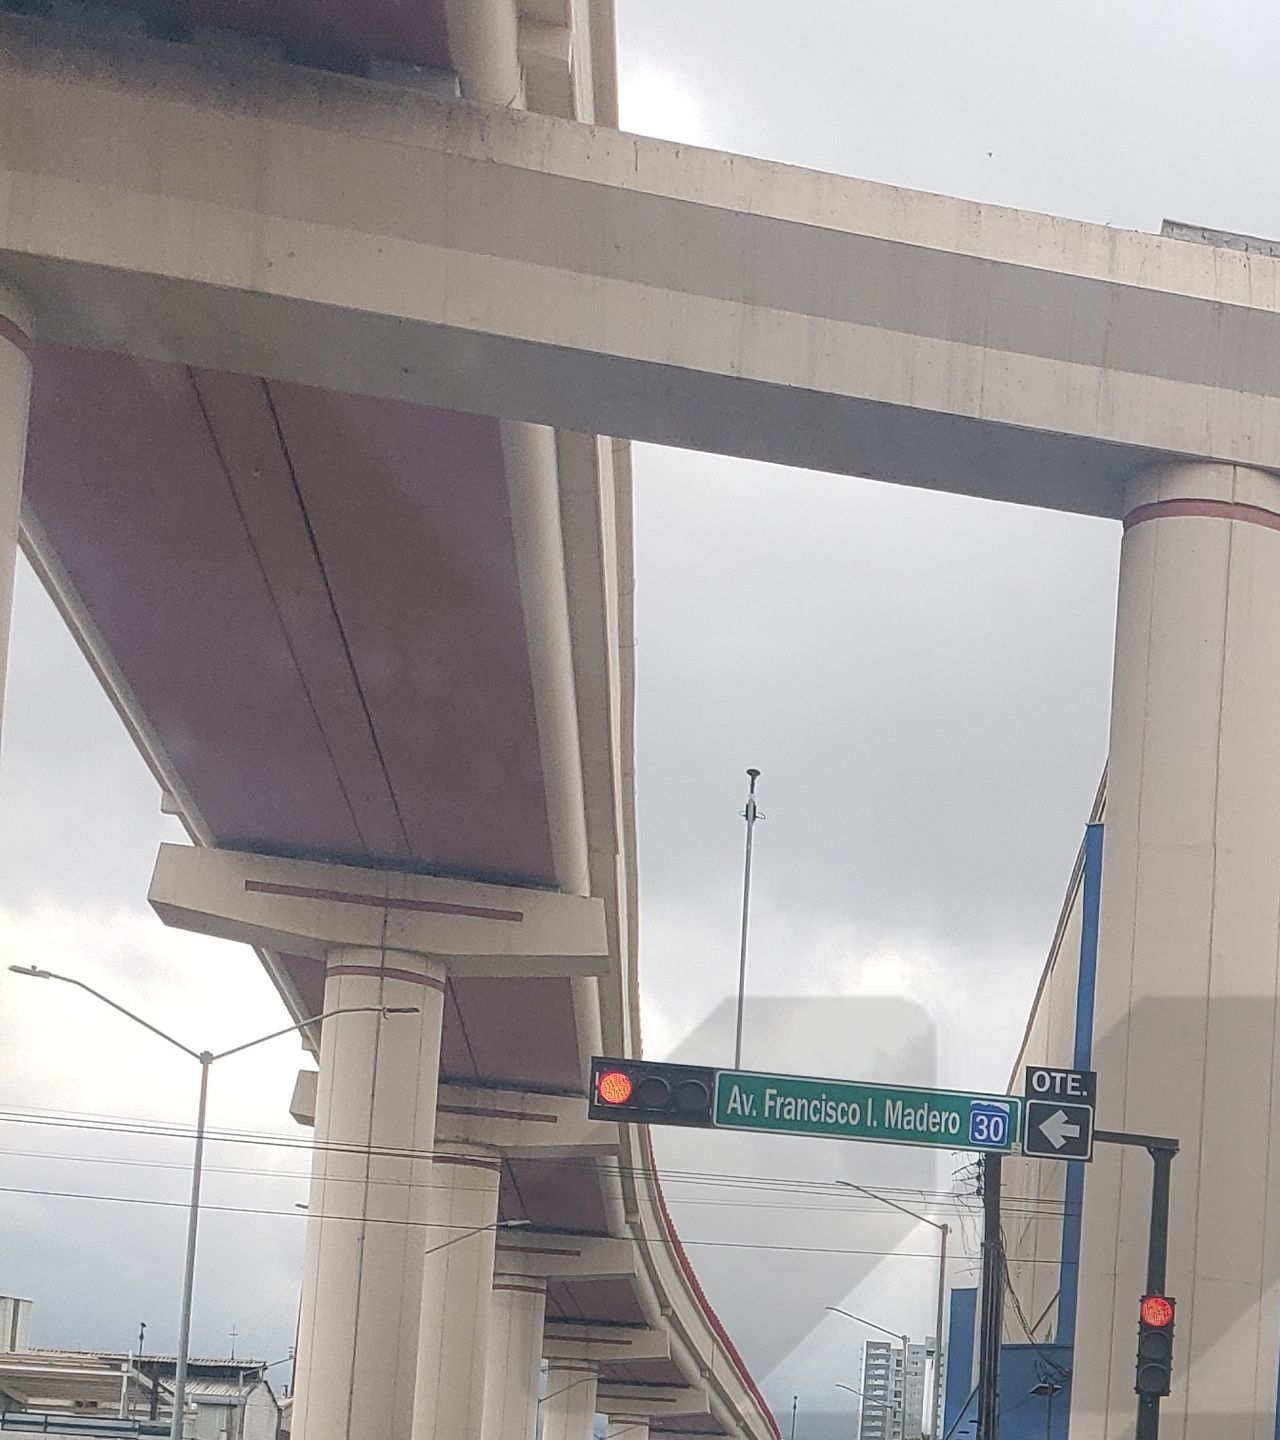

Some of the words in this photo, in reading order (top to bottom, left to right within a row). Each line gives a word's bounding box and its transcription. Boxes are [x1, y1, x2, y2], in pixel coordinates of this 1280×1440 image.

[1031, 1070, 1089, 1097] OTE.
[726, 1085, 757, 1118] Av.
[763, 1088, 861, 1126] Francisco
[866, 1102, 877, 1128] I.
[884, 1101, 961, 1135] Madero
[973, 1114, 1004, 1142] 30
